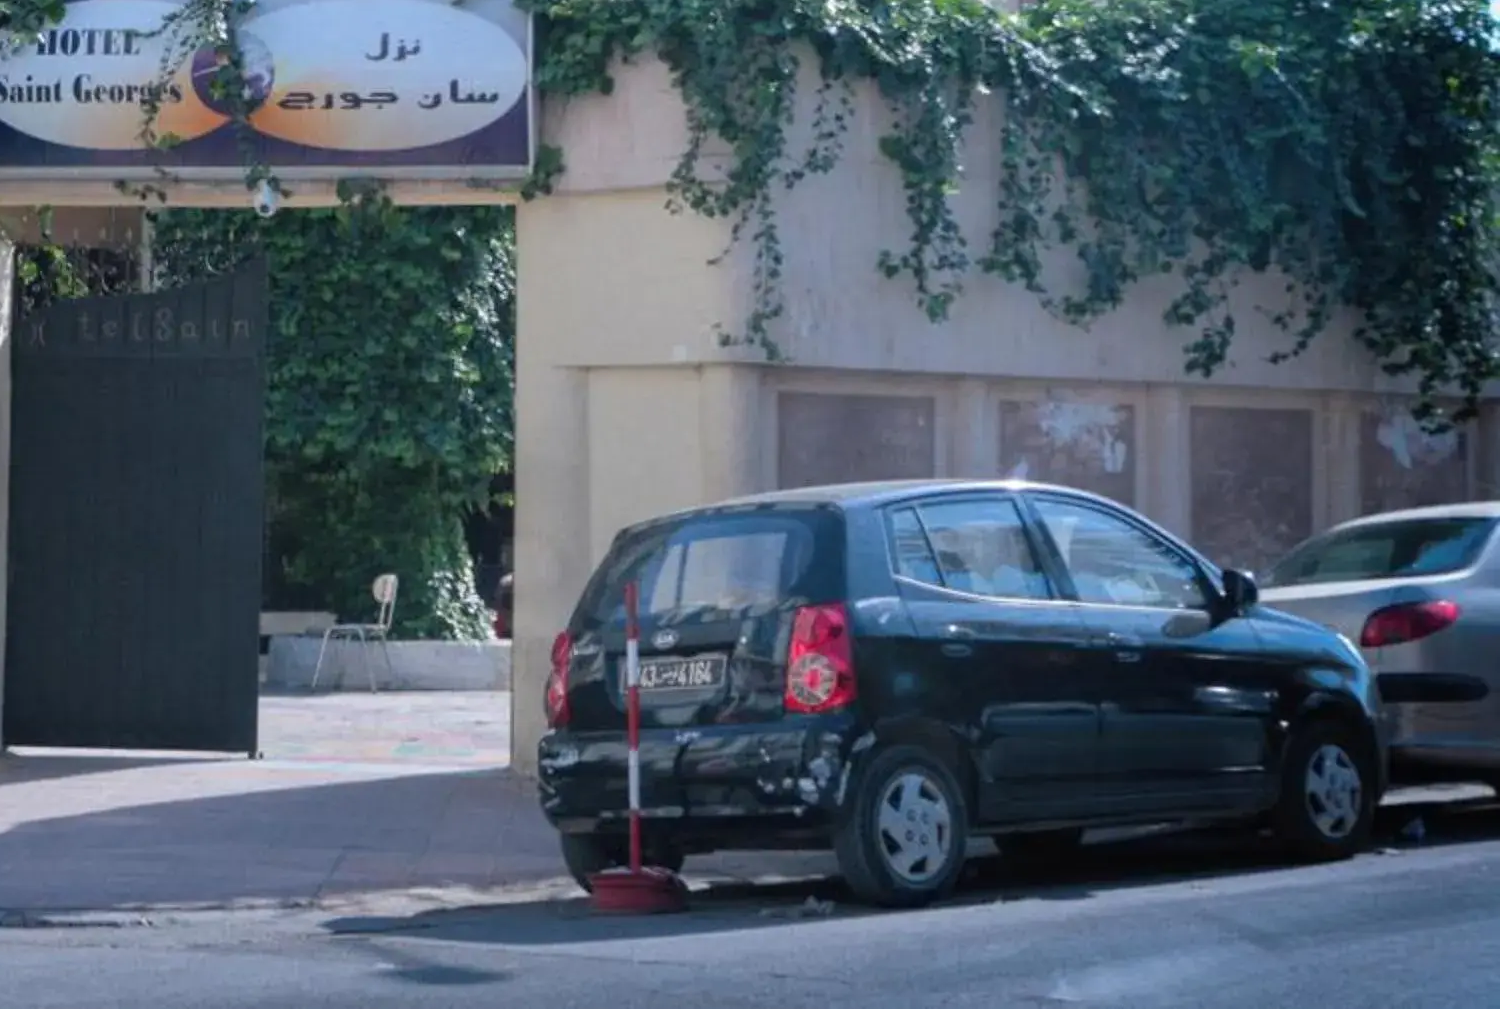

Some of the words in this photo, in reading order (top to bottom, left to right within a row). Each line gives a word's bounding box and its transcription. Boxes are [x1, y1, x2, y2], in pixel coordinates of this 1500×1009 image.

[364, 32, 422, 62] نزل
[276, 90, 399, 111] جورج
[417, 78, 500, 110] سان
